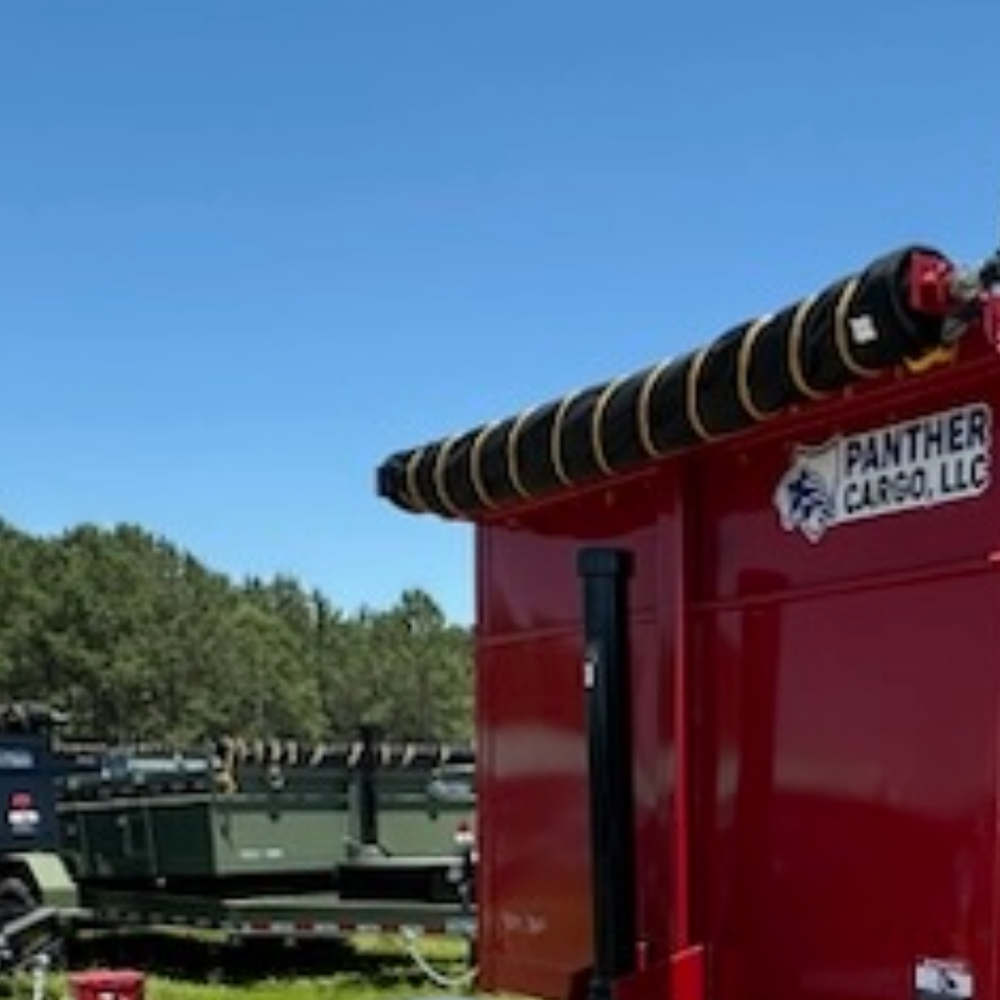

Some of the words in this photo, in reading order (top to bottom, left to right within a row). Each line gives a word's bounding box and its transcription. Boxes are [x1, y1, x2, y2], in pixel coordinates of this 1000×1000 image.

[846, 410, 986, 474] PANTHER
[843, 468, 933, 514] CARGO,
[940, 454, 986, 493] LLC
